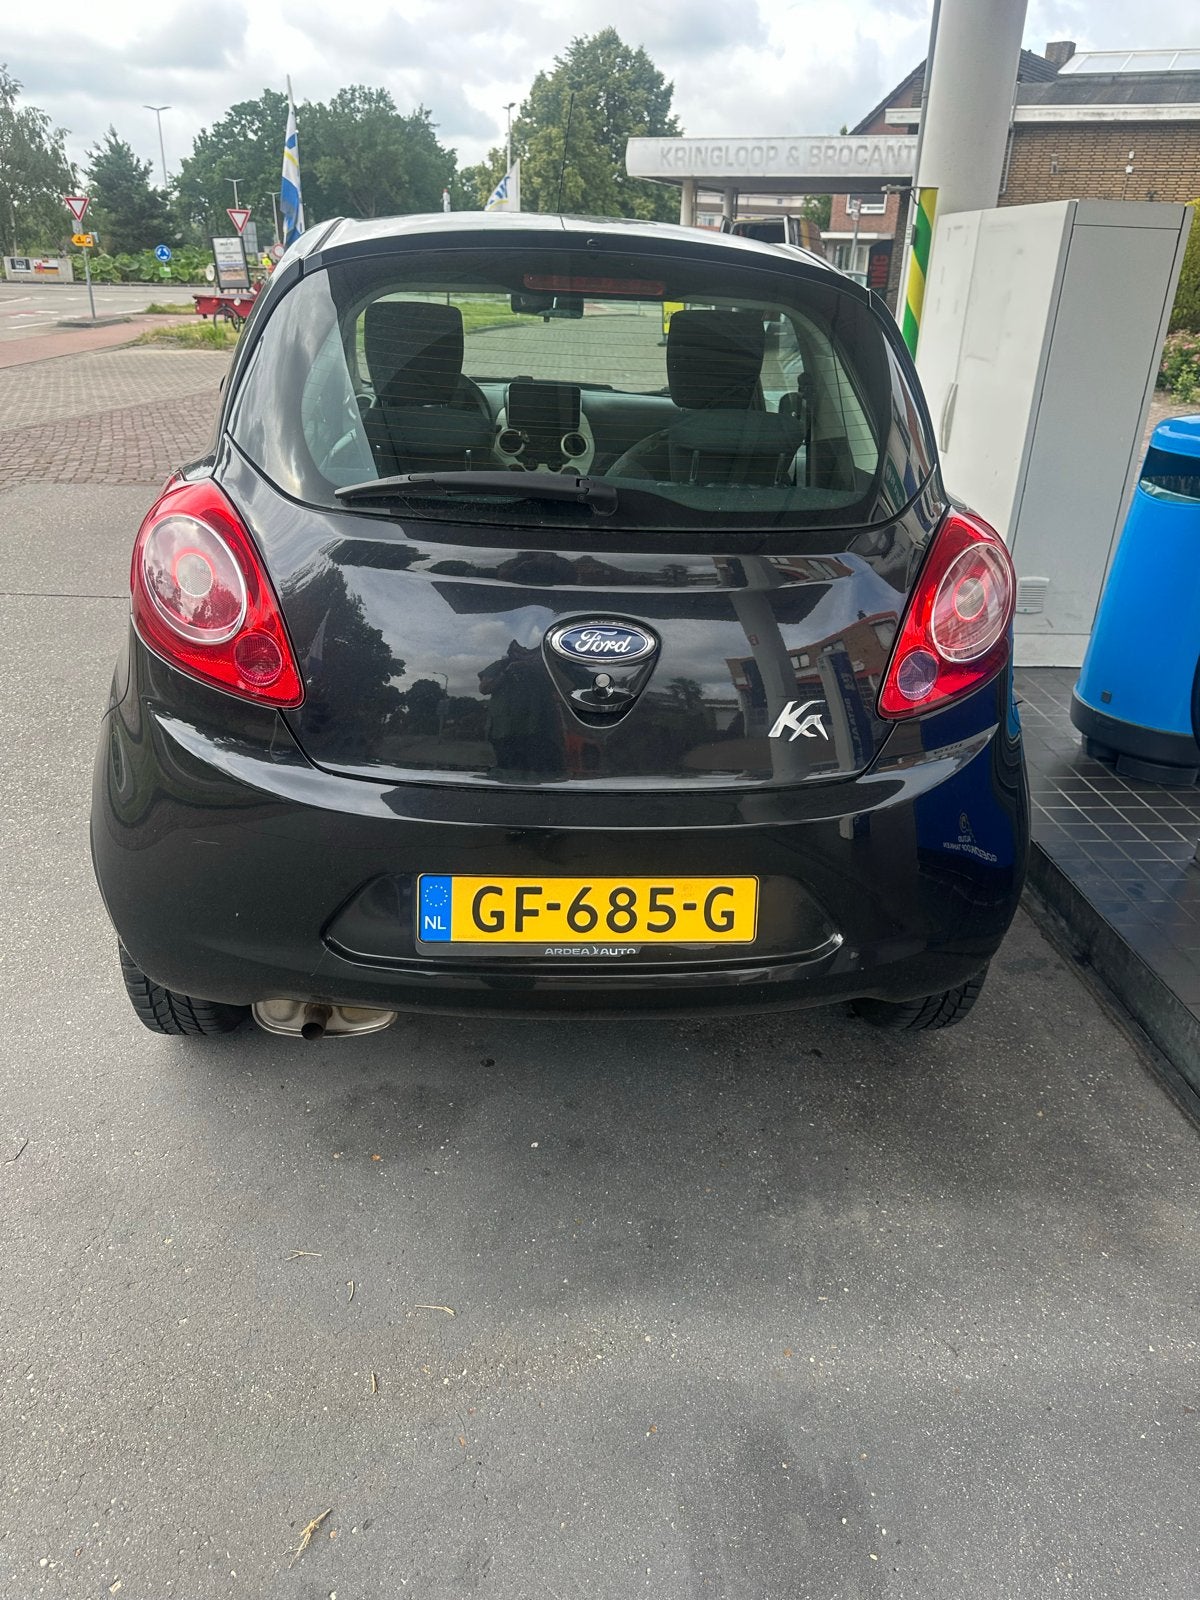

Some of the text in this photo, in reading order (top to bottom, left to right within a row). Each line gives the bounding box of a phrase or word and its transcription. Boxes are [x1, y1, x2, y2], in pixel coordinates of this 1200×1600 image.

[659, 145, 778, 168] KRINGLOOP
[785, 145, 801, 167] &
[574, 629, 632, 653] Ford
[472, 885, 735, 933] GF-685-G
[424, 915, 447, 930] NL
[545, 947, 637, 956] ARDEA AUTO
